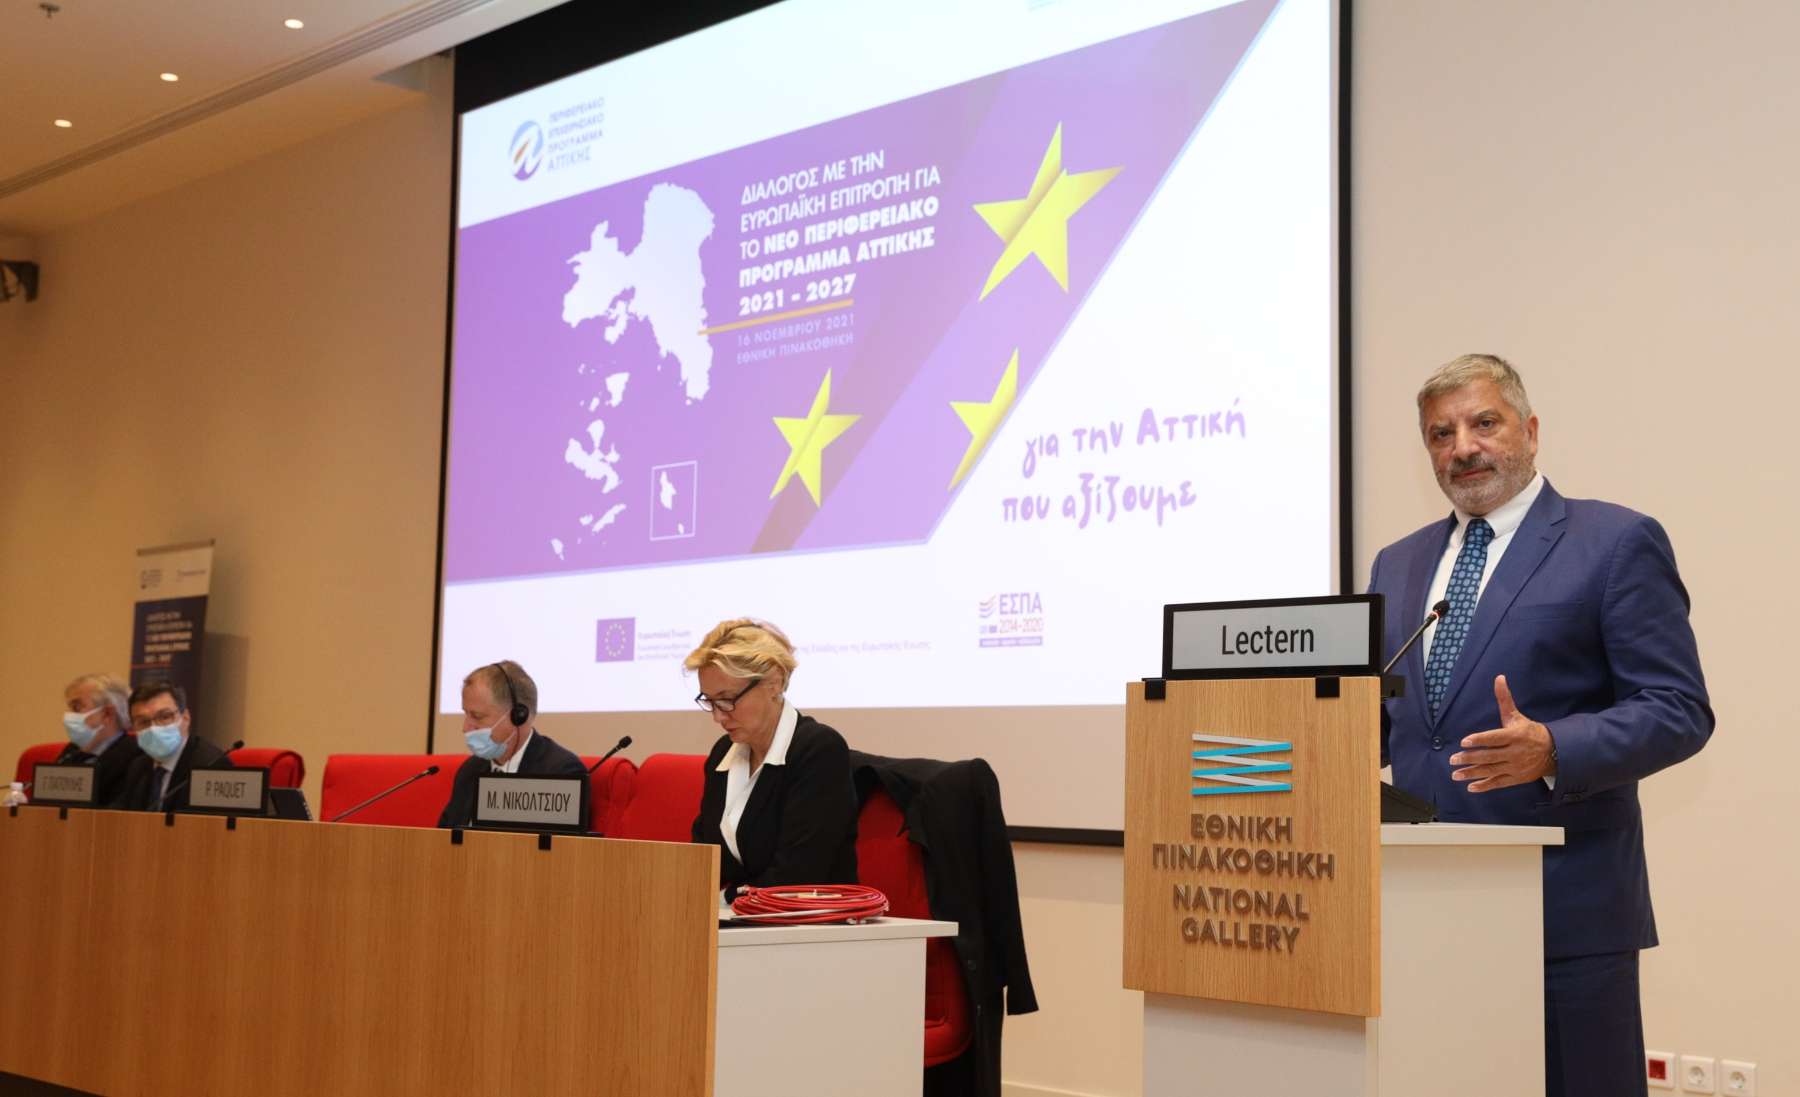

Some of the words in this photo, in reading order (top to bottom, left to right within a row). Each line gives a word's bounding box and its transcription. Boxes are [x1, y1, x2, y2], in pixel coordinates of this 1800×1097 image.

[741, 166, 819, 206] ΔΙΑΛΟΓΟΣ
[823, 160, 846, 185] ΜΕ
[850, 149, 884, 172] ΤΗΝ
[741, 193, 826, 233] ΕΥΡΩΠΑΪΚΗ
[830, 174, 910, 210] ΕΠΙΤΡΟΠΗ
[915, 165, 941, 190] ΓΙΑ
[740, 240, 760, 260] ΤΟ
[764, 230, 799, 256] ΝΕΟ
[804, 196, 939, 246] ΠΕΡΙΦΕΡΕΙΑΚΟ
[739, 246, 852, 288] ΠΡΟΓΡΑΜΜΑ
[856, 227, 936, 263] ΑΤΤΙΚΗΣ
[739, 289, 784, 316] 2021
[806, 273, 857, 302] 2027
[737, 333, 751, 347] 16
[753, 319, 821, 344] ΝΟΕΜΒΡΙΟΥ
[826, 312, 854, 331] 2021
[737, 347, 776, 365] ΕΘΝΙΚΗ
[779, 332, 854, 357] ΠΙΝΑΚΟΘΗΚΗ
[1022, 433, 1059, 479] για
[1072, 421, 1123, 454] την
[1136, 397, 1246, 446] Αττική
[1002, 495, 1050, 522] που
[1062, 472, 1197, 530] αξίζουμε
[999, 592, 1043, 615] ΕΣΠΑ
[1221, 624, 1315, 656] Lectern
[214, 781, 247, 799] PAQUET
[487, 791, 499, 809] Μ.
[503, 792, 571, 812] ΝΙΚΟΛΤΣΙΟΥ
[1190, 813, 1293, 843] ΕΘΝΙΚΗ
[1152, 843, 1335, 880] ΠΙΝΑΚΟΘΗΚΗ
[1173, 884, 1310, 921] NATIONAL
[1181, 917, 1300, 953] GALLERY
